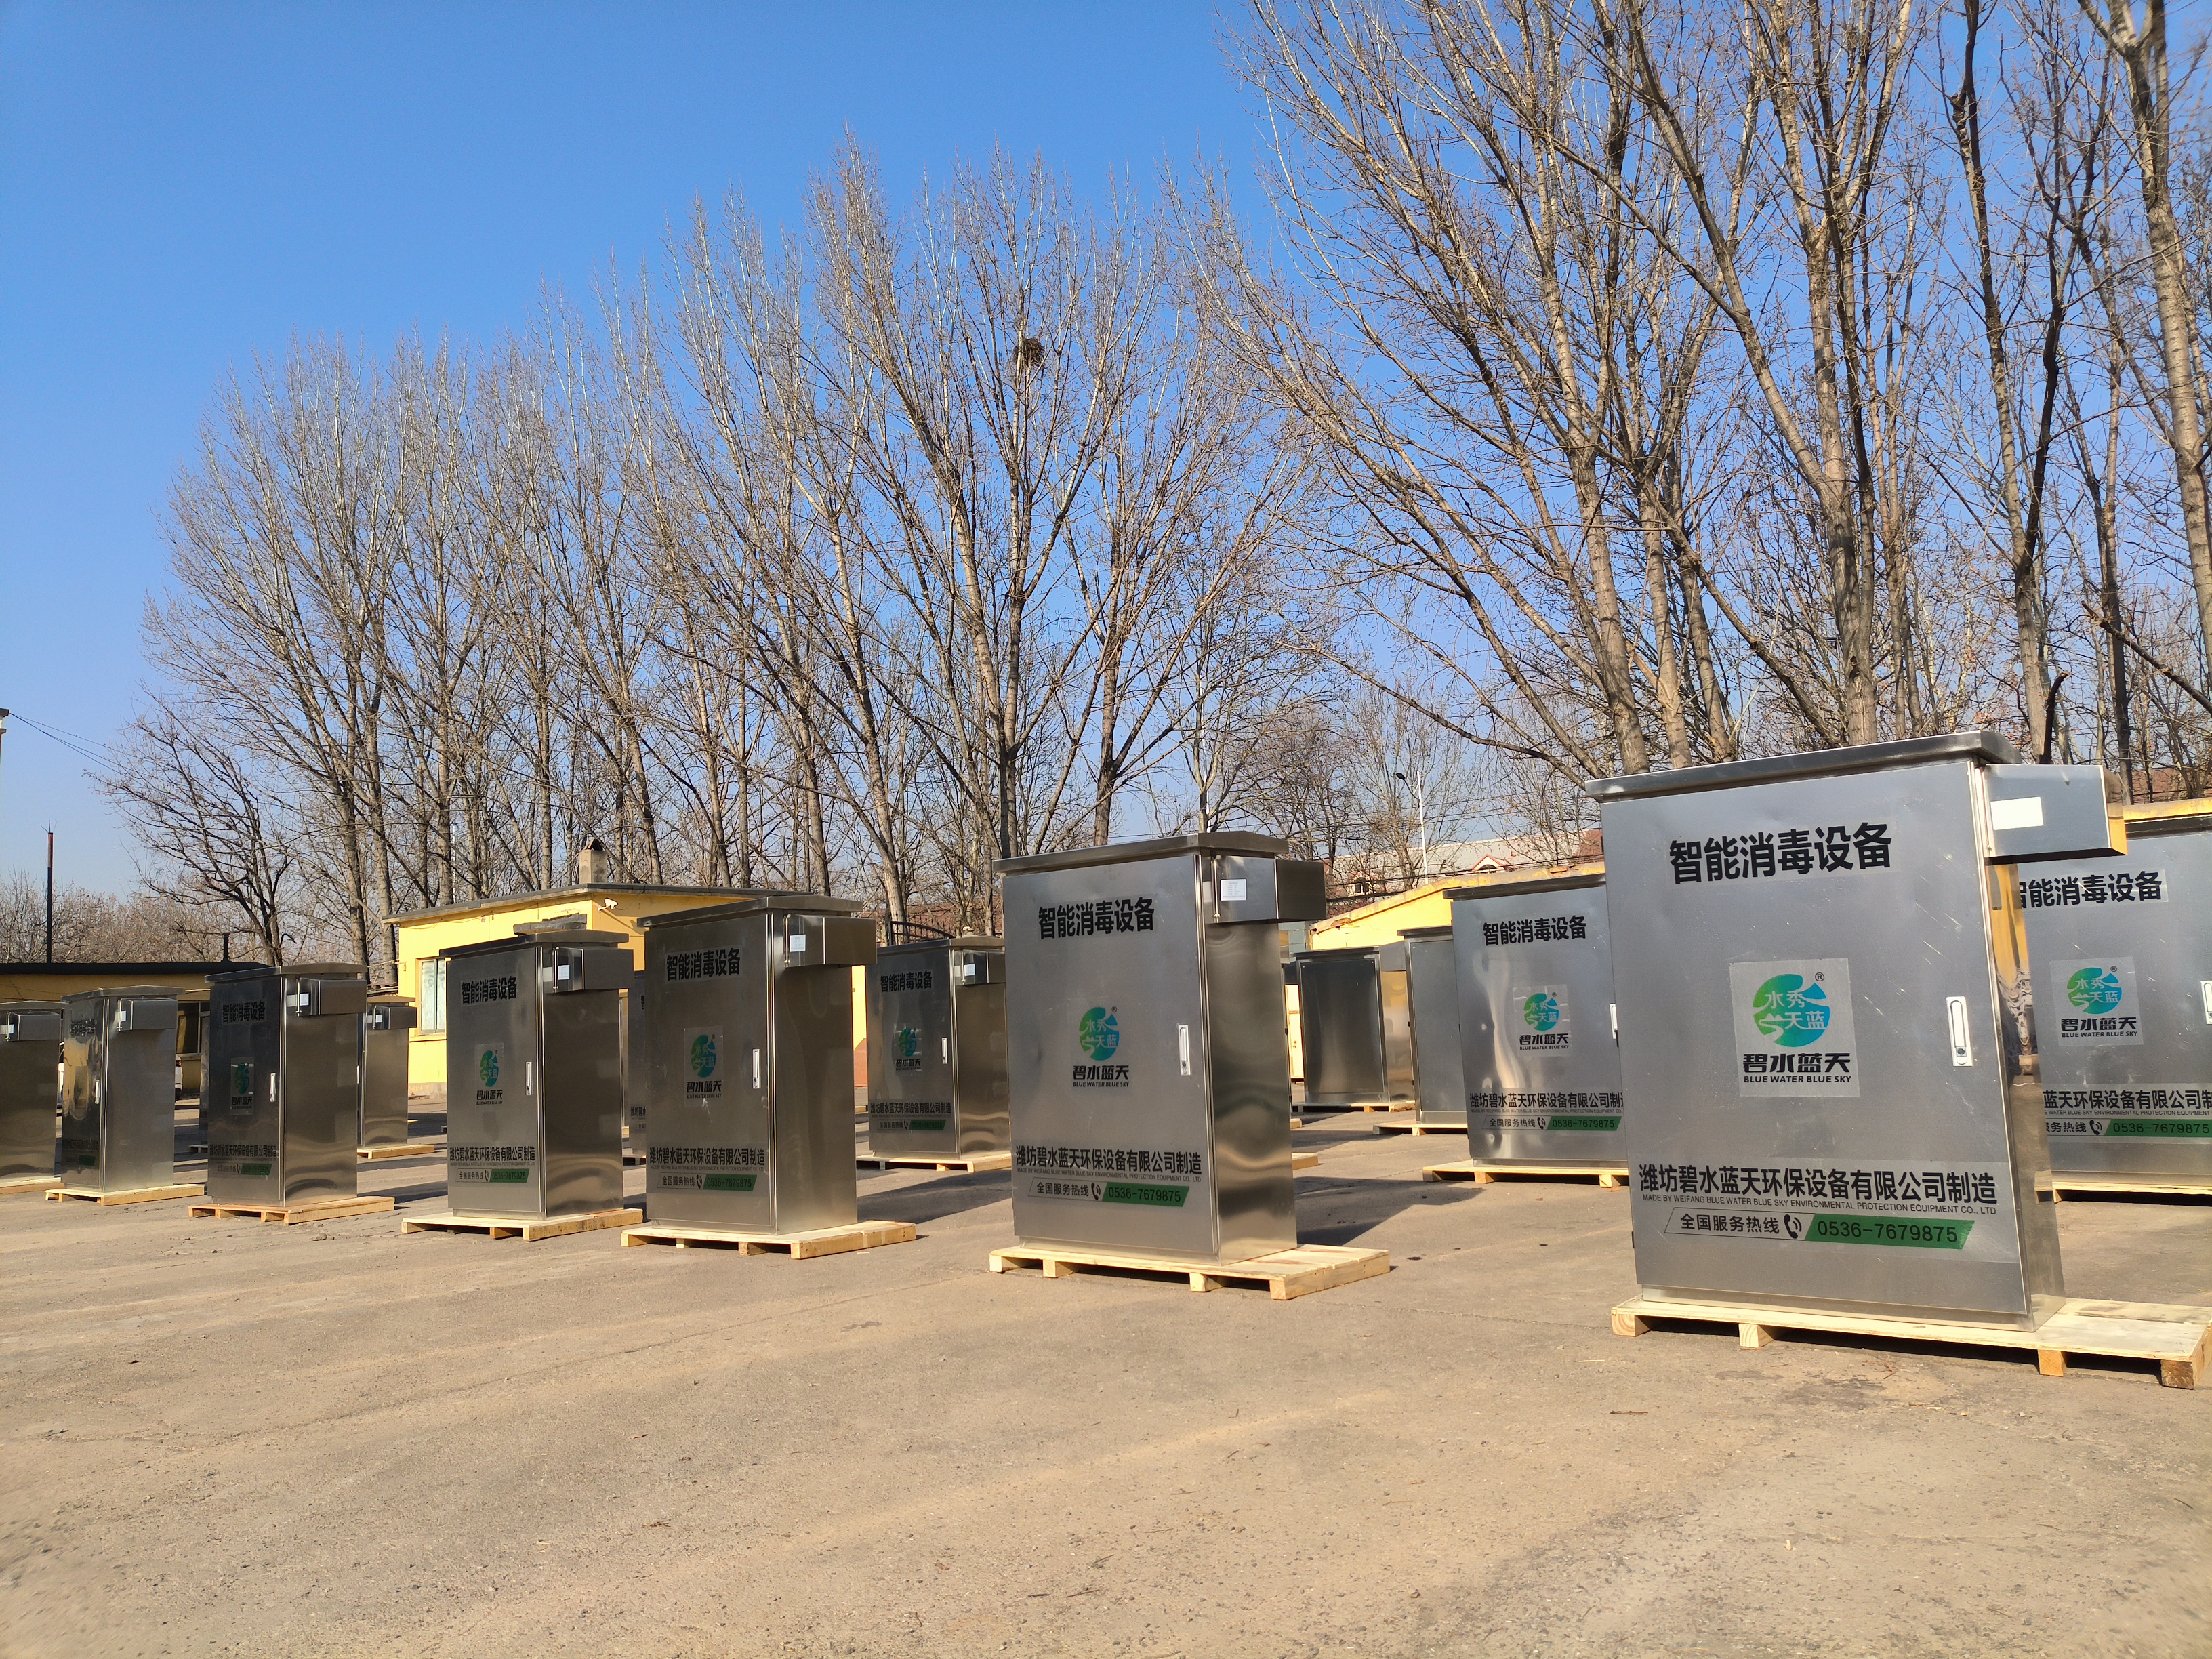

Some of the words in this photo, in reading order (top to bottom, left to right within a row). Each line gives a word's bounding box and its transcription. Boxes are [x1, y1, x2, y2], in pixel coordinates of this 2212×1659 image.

[1669, 822, 1891, 884] 智能消毒设备
[1038, 897, 1154, 939] 智能消毒设备
[1483, 915, 1586, 945] 智能消毒设备
[667, 947, 740, 981] 智能消毒设备
[462, 976, 517, 1004] 智能消毒设备
[880, 970, 932, 993] 智能消毒设备
[2075, 978, 2104, 989] 水秀
[1765, 991, 1805, 1008] 水秀
[2090, 991, 2118, 1003] 天蓝
[222, 1001, 265, 1023] 智能消毒设备
[1785, 1011, 1826, 1029] 天蓝
[2061, 1017, 2137, 1031] 碧水蓝天
[1519, 1033, 1569, 1045] 碧水蓝天
[1743, 1053, 1851, 1073] 碧水蓝天
[1073, 1065, 1129, 1080] 碧水蓝天
[687, 1080, 721, 1093] 碧水蓝天
[1490, 1118, 1536, 1127] 全国服务热线
[1553, 1119, 1614, 1128] 0536-7679875
[2113, 1122, 2209, 1134] 0536-7679875
[449, 1146, 535, 1161] 潍坊碧水蓝天环保设备有限公司制造
[649, 1147, 764, 1165] 潍坊碧水蓝天环保设备有限公司制造
[1017, 1145, 1202, 1175] 潍坊碧水蓝天环保设备有限公司制造
[663, 1176, 695, 1186] 全国服务热线
[707, 1177, 751, 1187] 0536-7679875
[1639, 1164, 1997, 1204] 潍坊碧水蓝天环保设备有限公司制造
[1037, 1182, 1089, 1197] 全国服务热线
[1109, 1187, 1181, 1202] 0536-7679875
[1674, 1195, 1704, 1203] WEIFANG
[1791, 1200, 1855, 1209] ENVIRONMENTAL
[1857, 1202, 1908, 1211] PROTECTION
[1910, 1204, 1958, 1212] EQUIPMENT
[1680, 1213, 1780, 1234] 全国服务热线
[1818, 1221, 1957, 1242] 0536-7679875
